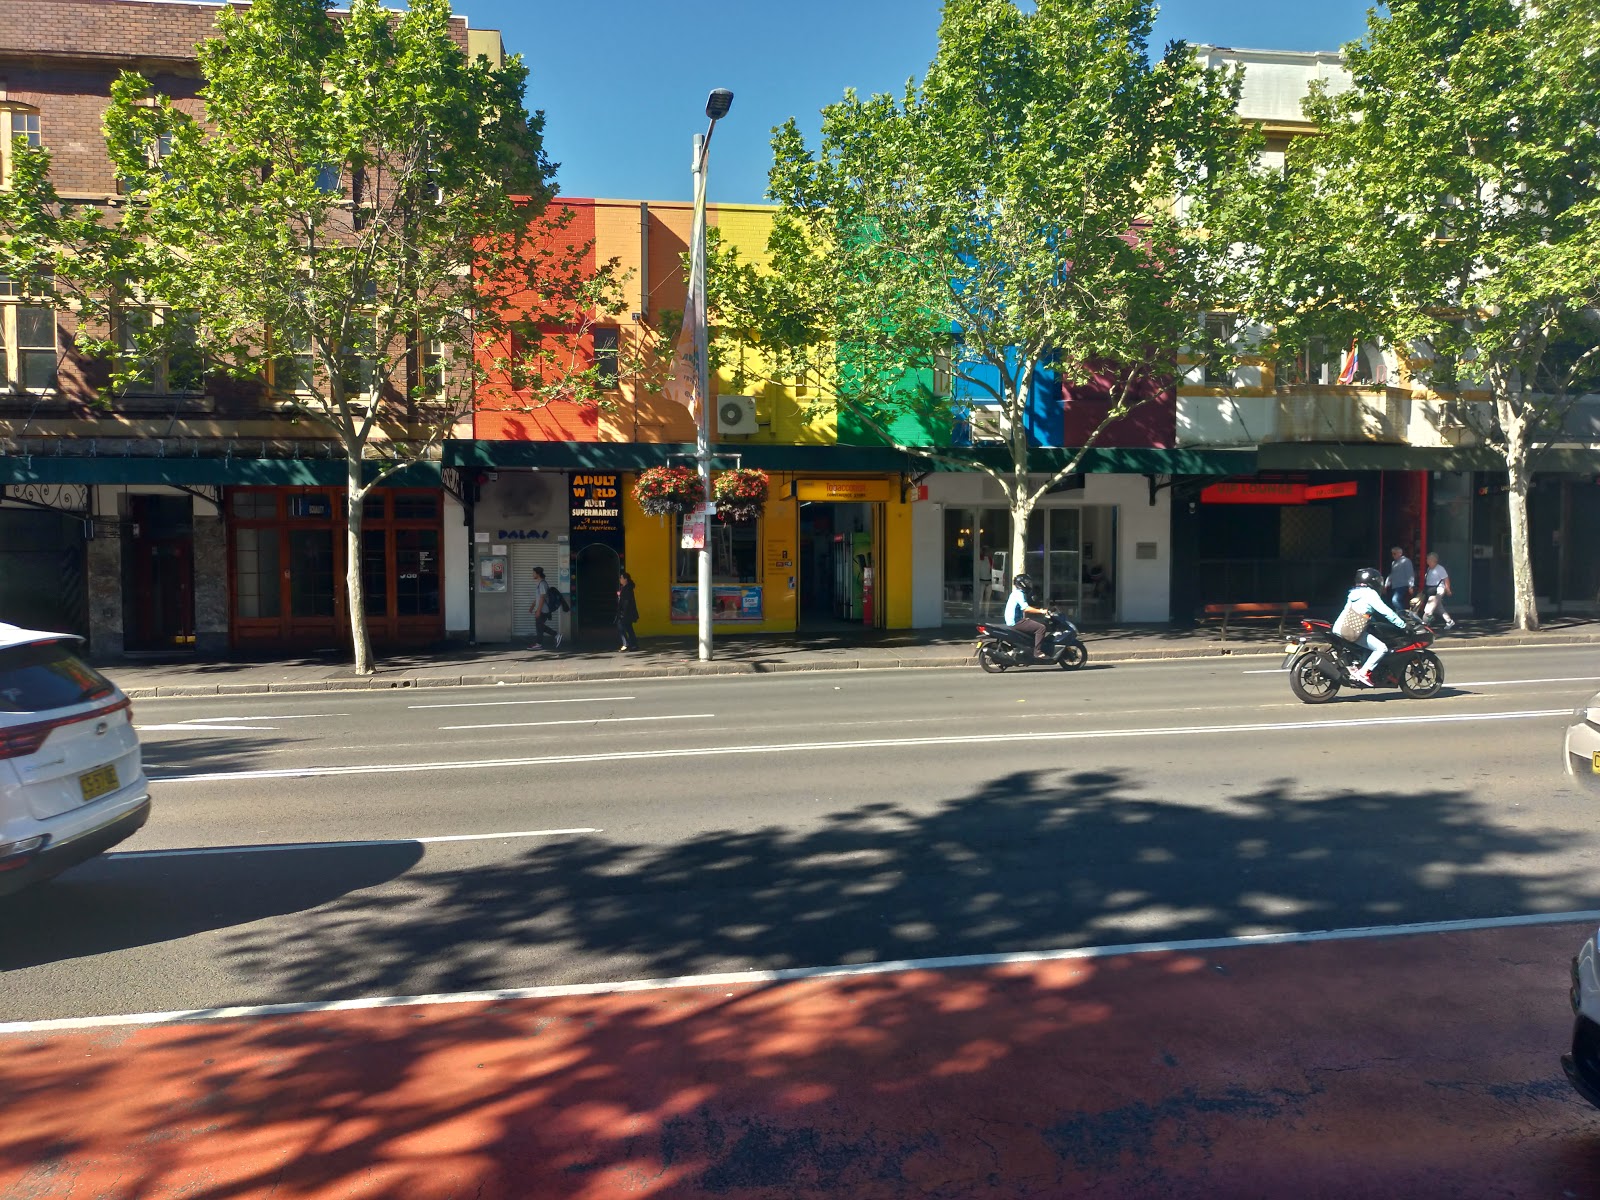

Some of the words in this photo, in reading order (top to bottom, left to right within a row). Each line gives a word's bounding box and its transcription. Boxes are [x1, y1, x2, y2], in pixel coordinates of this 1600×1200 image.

[573, 475, 616, 486] ADULT
[573, 488, 617, 498] WRLD
[572, 508, 619, 517] SUPERMARKET
